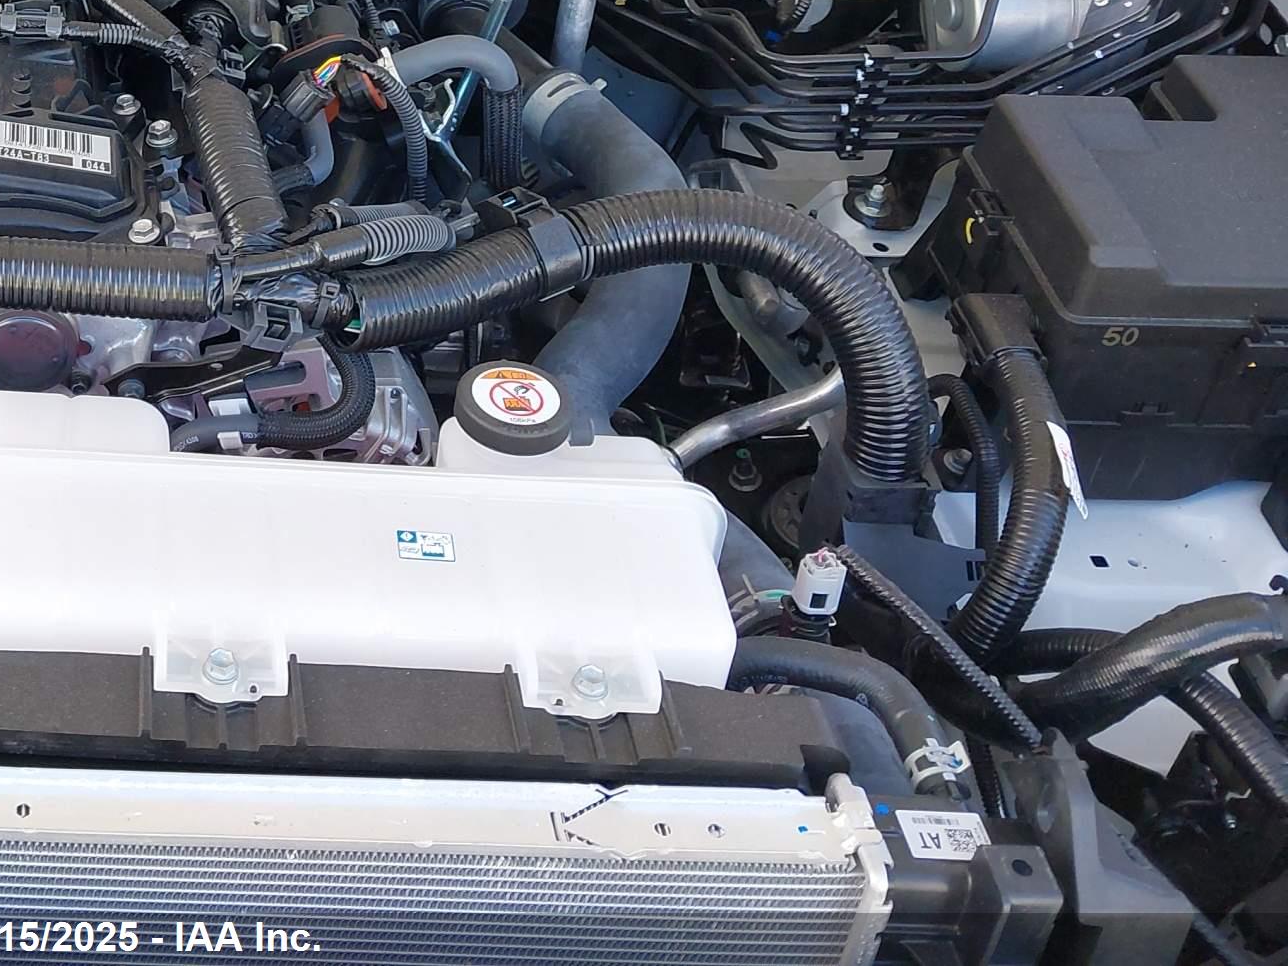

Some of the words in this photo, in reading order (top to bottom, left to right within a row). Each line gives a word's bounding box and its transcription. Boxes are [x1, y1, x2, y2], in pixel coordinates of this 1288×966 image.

[85, 160, 107, 172] 044
[1102, 326, 1140, 347] 50
[918, 832, 942, 850] AT
